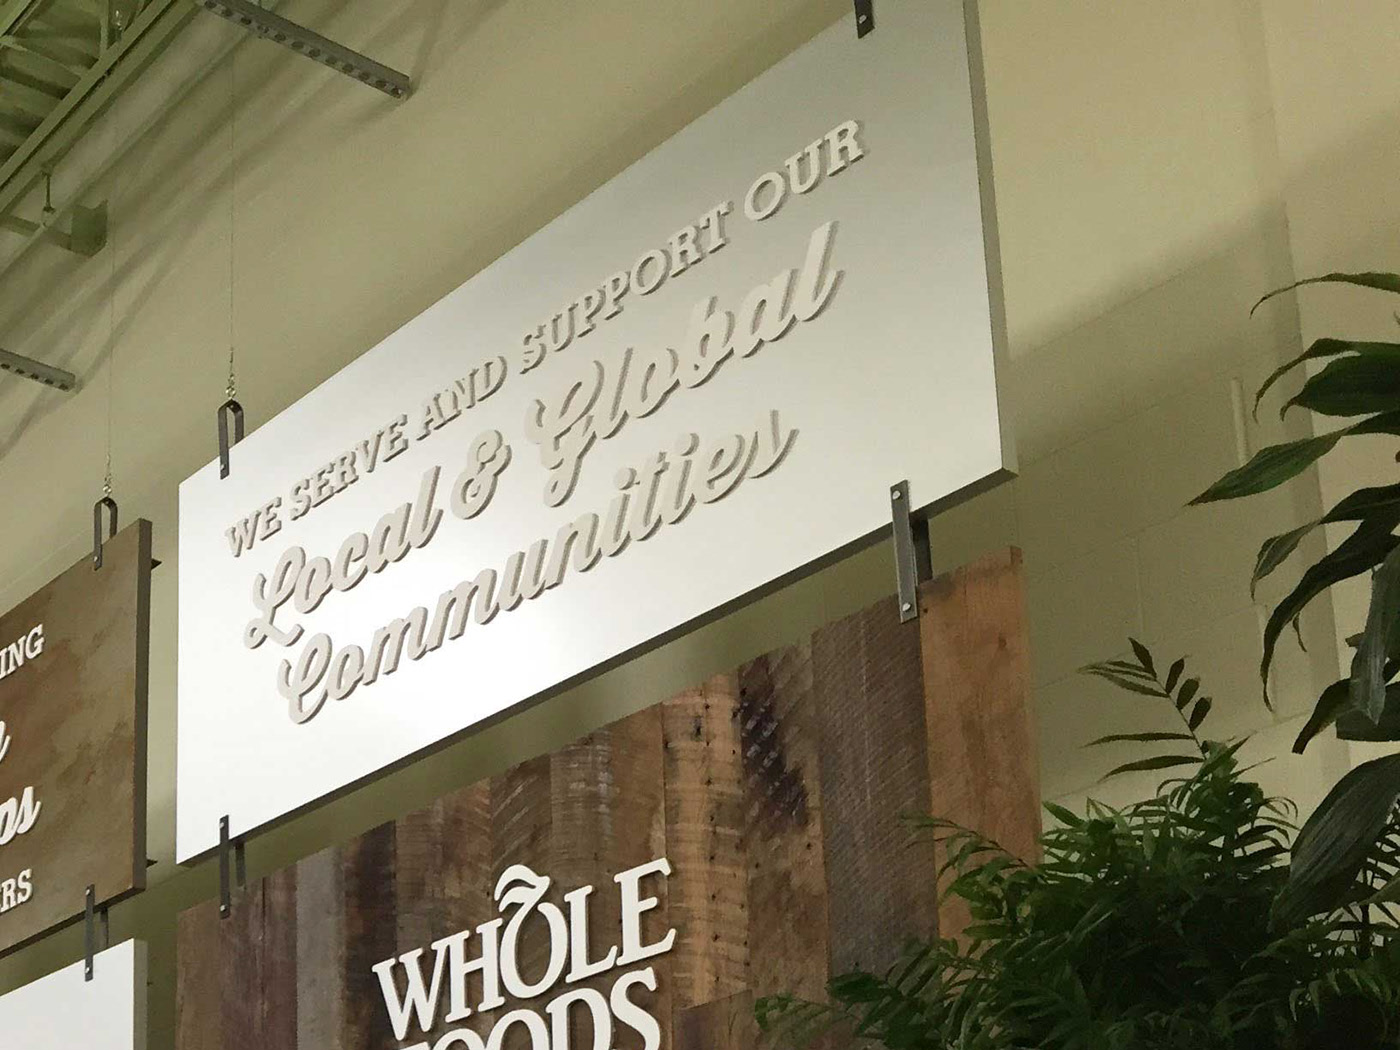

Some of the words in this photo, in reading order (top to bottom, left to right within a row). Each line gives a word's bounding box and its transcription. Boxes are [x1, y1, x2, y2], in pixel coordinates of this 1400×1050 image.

[224, 499, 282, 559] WE
[289, 413, 410, 522] SERVE
[416, 355, 509, 442] AND
[519, 200, 732, 378] SUPPORT
[744, 120, 865, 223] OUR
[245, 464, 442, 648] Local
[451, 429, 512, 522] &
[525, 219, 846, 508] Global
[278, 409, 798, 726] Communities
[372, 857, 677, 1041] WHOLE
